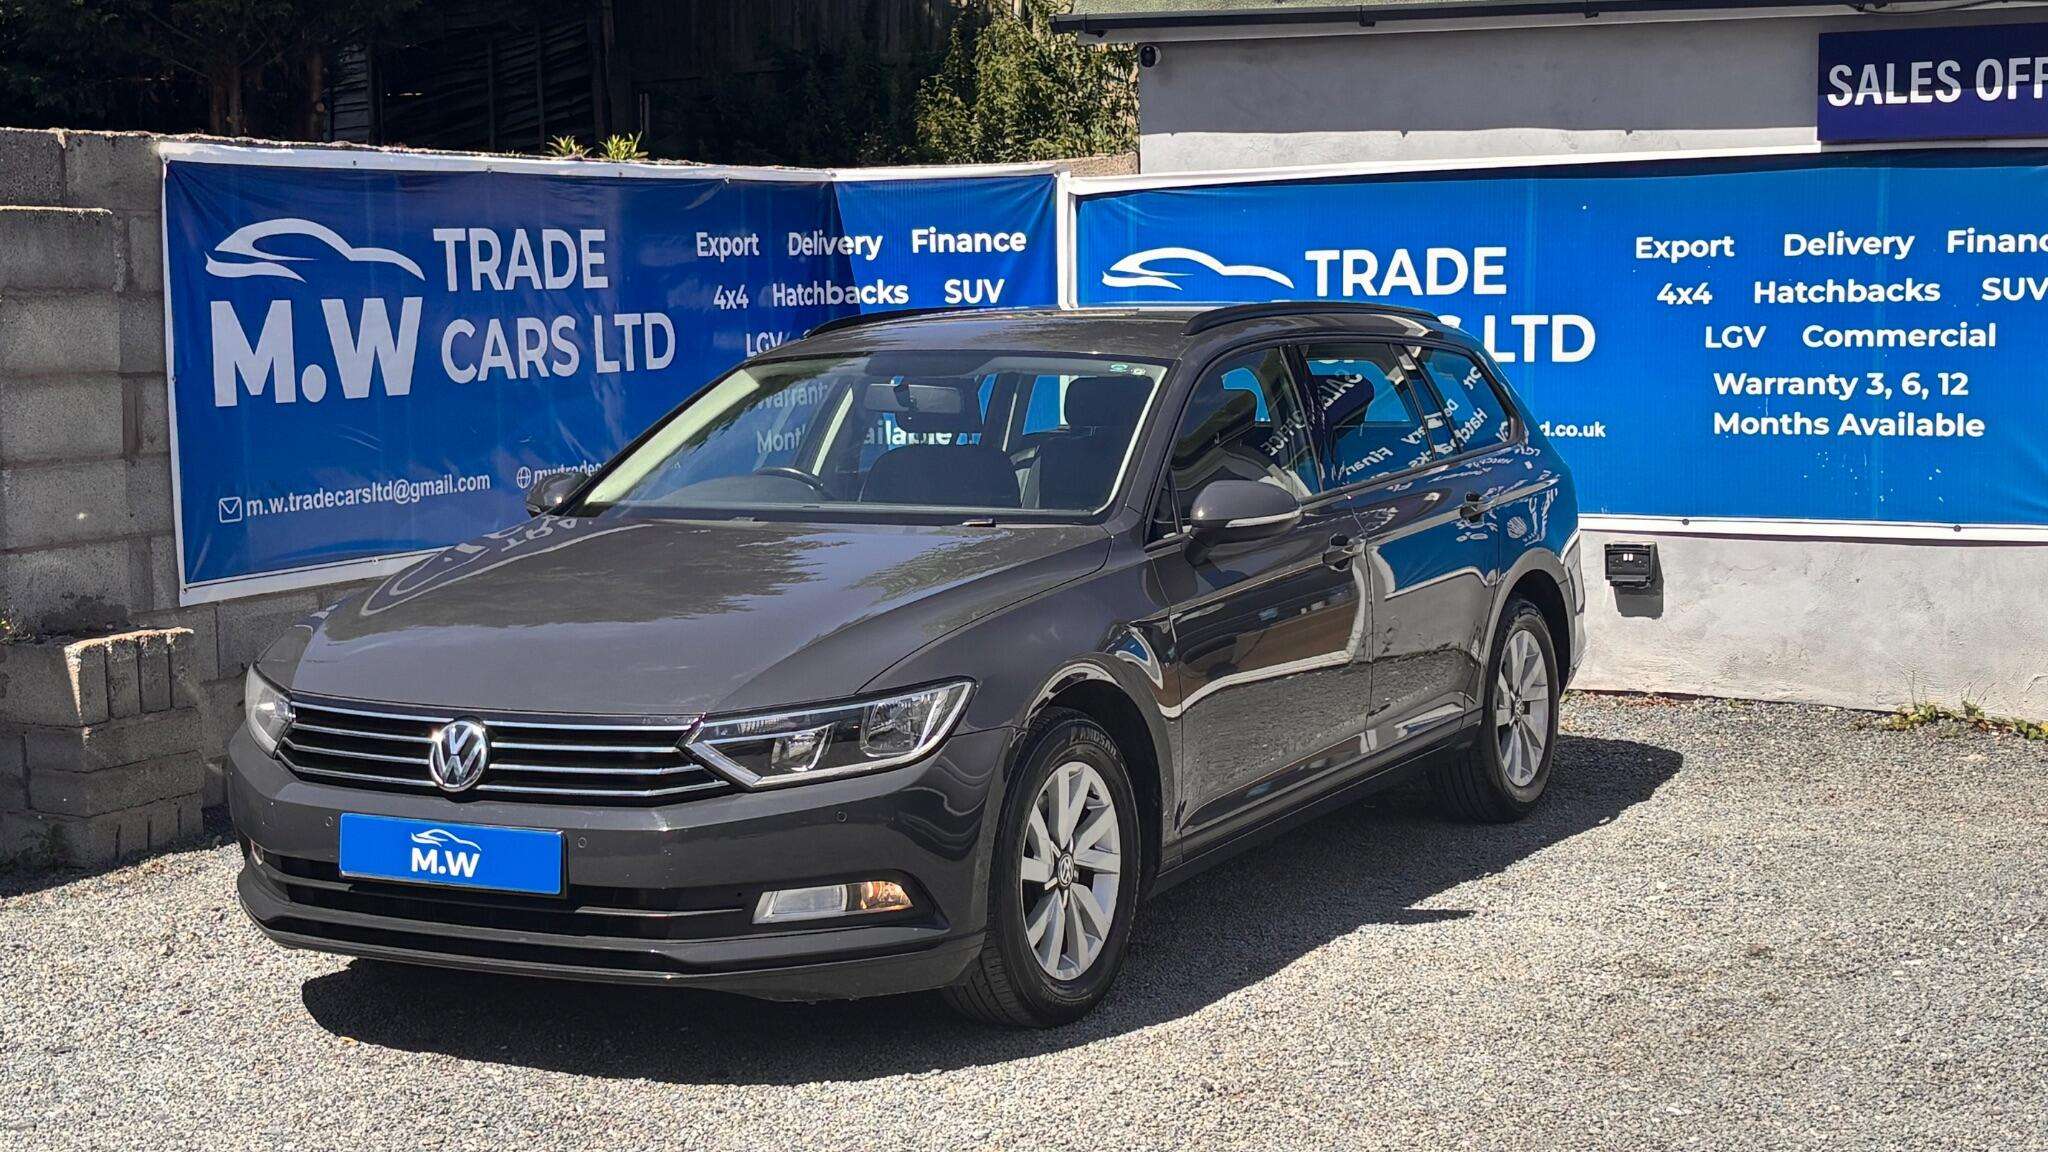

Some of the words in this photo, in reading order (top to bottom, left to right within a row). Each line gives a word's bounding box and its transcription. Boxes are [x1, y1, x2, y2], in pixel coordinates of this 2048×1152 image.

[1827, 59, 1962, 106] SALES
[433, 228, 609, 292] TRADE
[696, 231, 760, 262] Export
[788, 229, 883, 261] Delivery
[911, 226, 1027, 254] Finance
[1635, 235, 1735, 264] Export
[1783, 231, 1916, 261] Delivery
[1304, 246, 1507, 297] TRADE
[713, 284, 749, 310] 4x4
[772, 279, 910, 308] Hatchbacks
[944, 278, 1005, 305] SUV
[1656, 282, 1713, 306] 4x4
[1753, 277, 1941, 304] Hatchbacks
[1981, 276, 2048, 302] SUV
[210, 296, 423, 408] M.W
[441, 314, 580, 385] CARS
[594, 312, 676, 374] LTD
[1483, 314, 1597, 363] LTD
[1705, 325, 1767, 349] LGV
[1802, 321, 1998, 349] Commercial
[757, 382, 829, 411] Warrant
[1713, 372, 1859, 401] Warranty
[1865, 372, 1893, 400] 3,
[1900, 372, 1930, 400] 6,
[1937, 372, 1969, 396] 12
[1713, 411, 1830, 436] Months
[1837, 411, 1986, 438] Available
[246, 474, 491, 518] m.w.tradecarsltd@gmail.com
[411, 847, 480, 878] M.W
